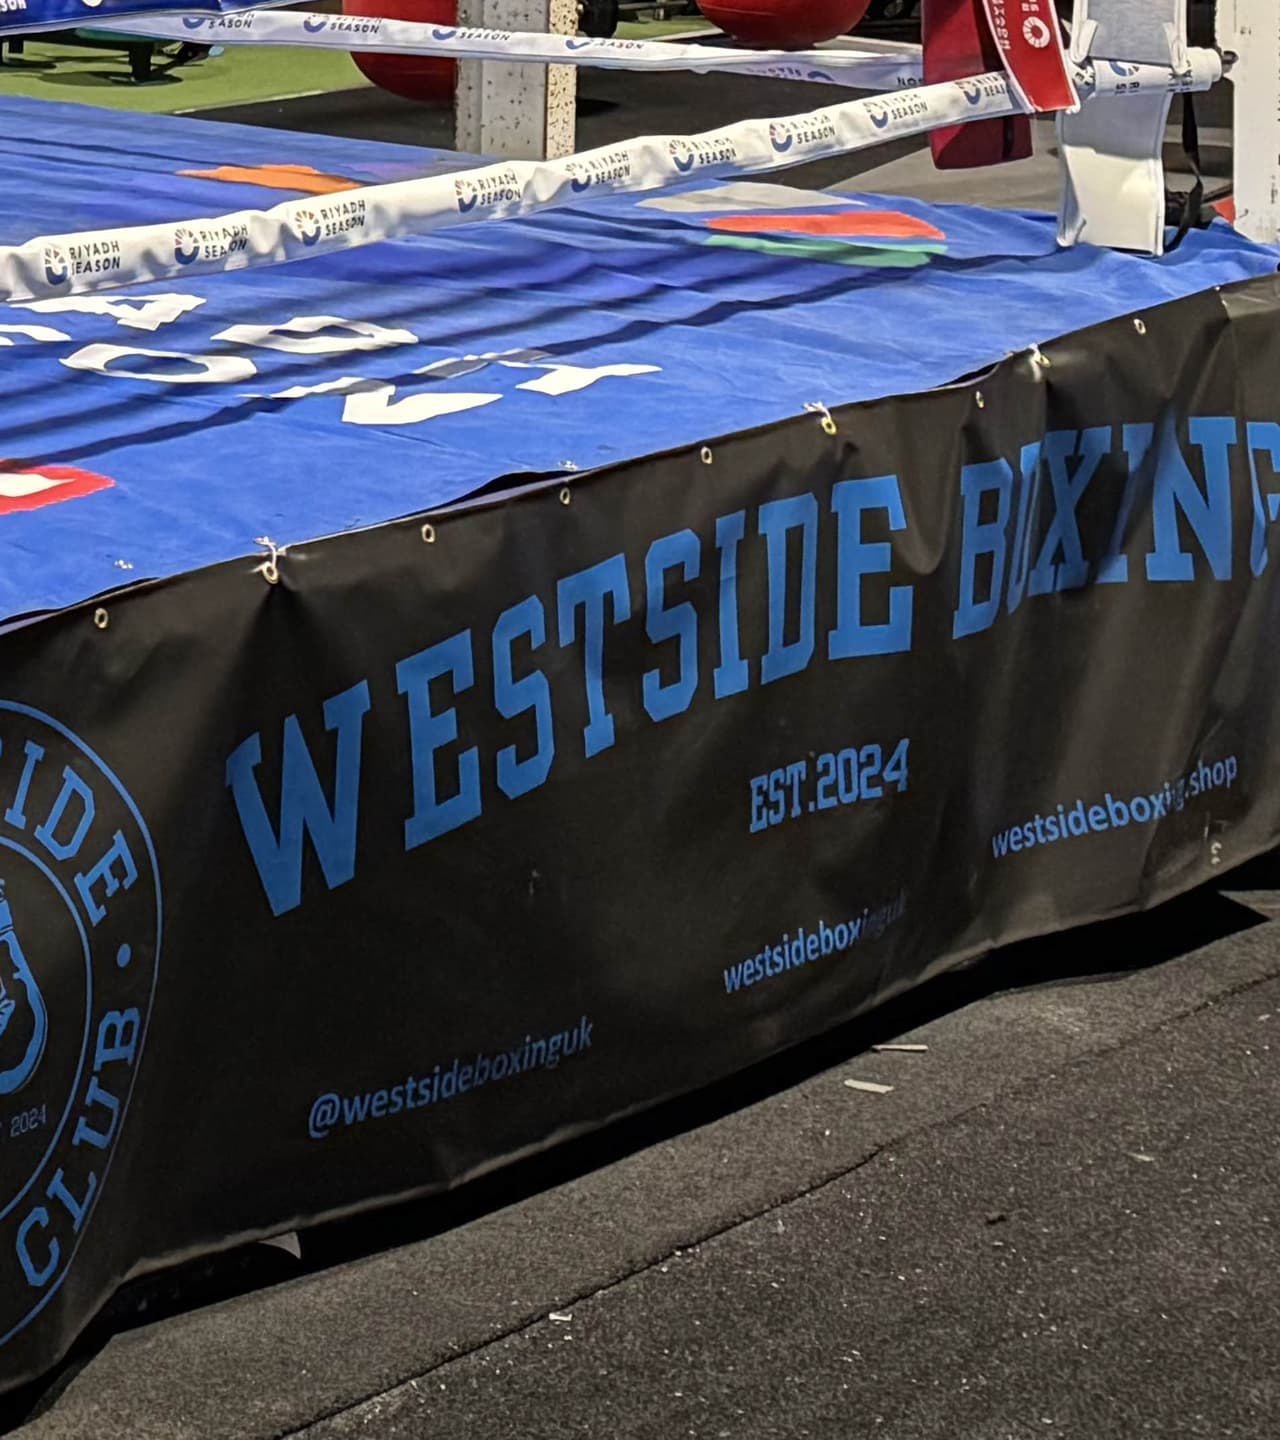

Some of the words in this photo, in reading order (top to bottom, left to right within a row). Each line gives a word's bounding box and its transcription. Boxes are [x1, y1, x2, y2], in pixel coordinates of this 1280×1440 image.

[320, 199, 365, 224] RIYADH
[326, 214, 365, 236] SEASON
[226, 475, 913, 917] WESTSIDE
[749, 738, 911, 833] EST.2024
[308, 1016, 594, 1139] @westsideboxinguk
[15, 1007, 141, 1287] CLUB
